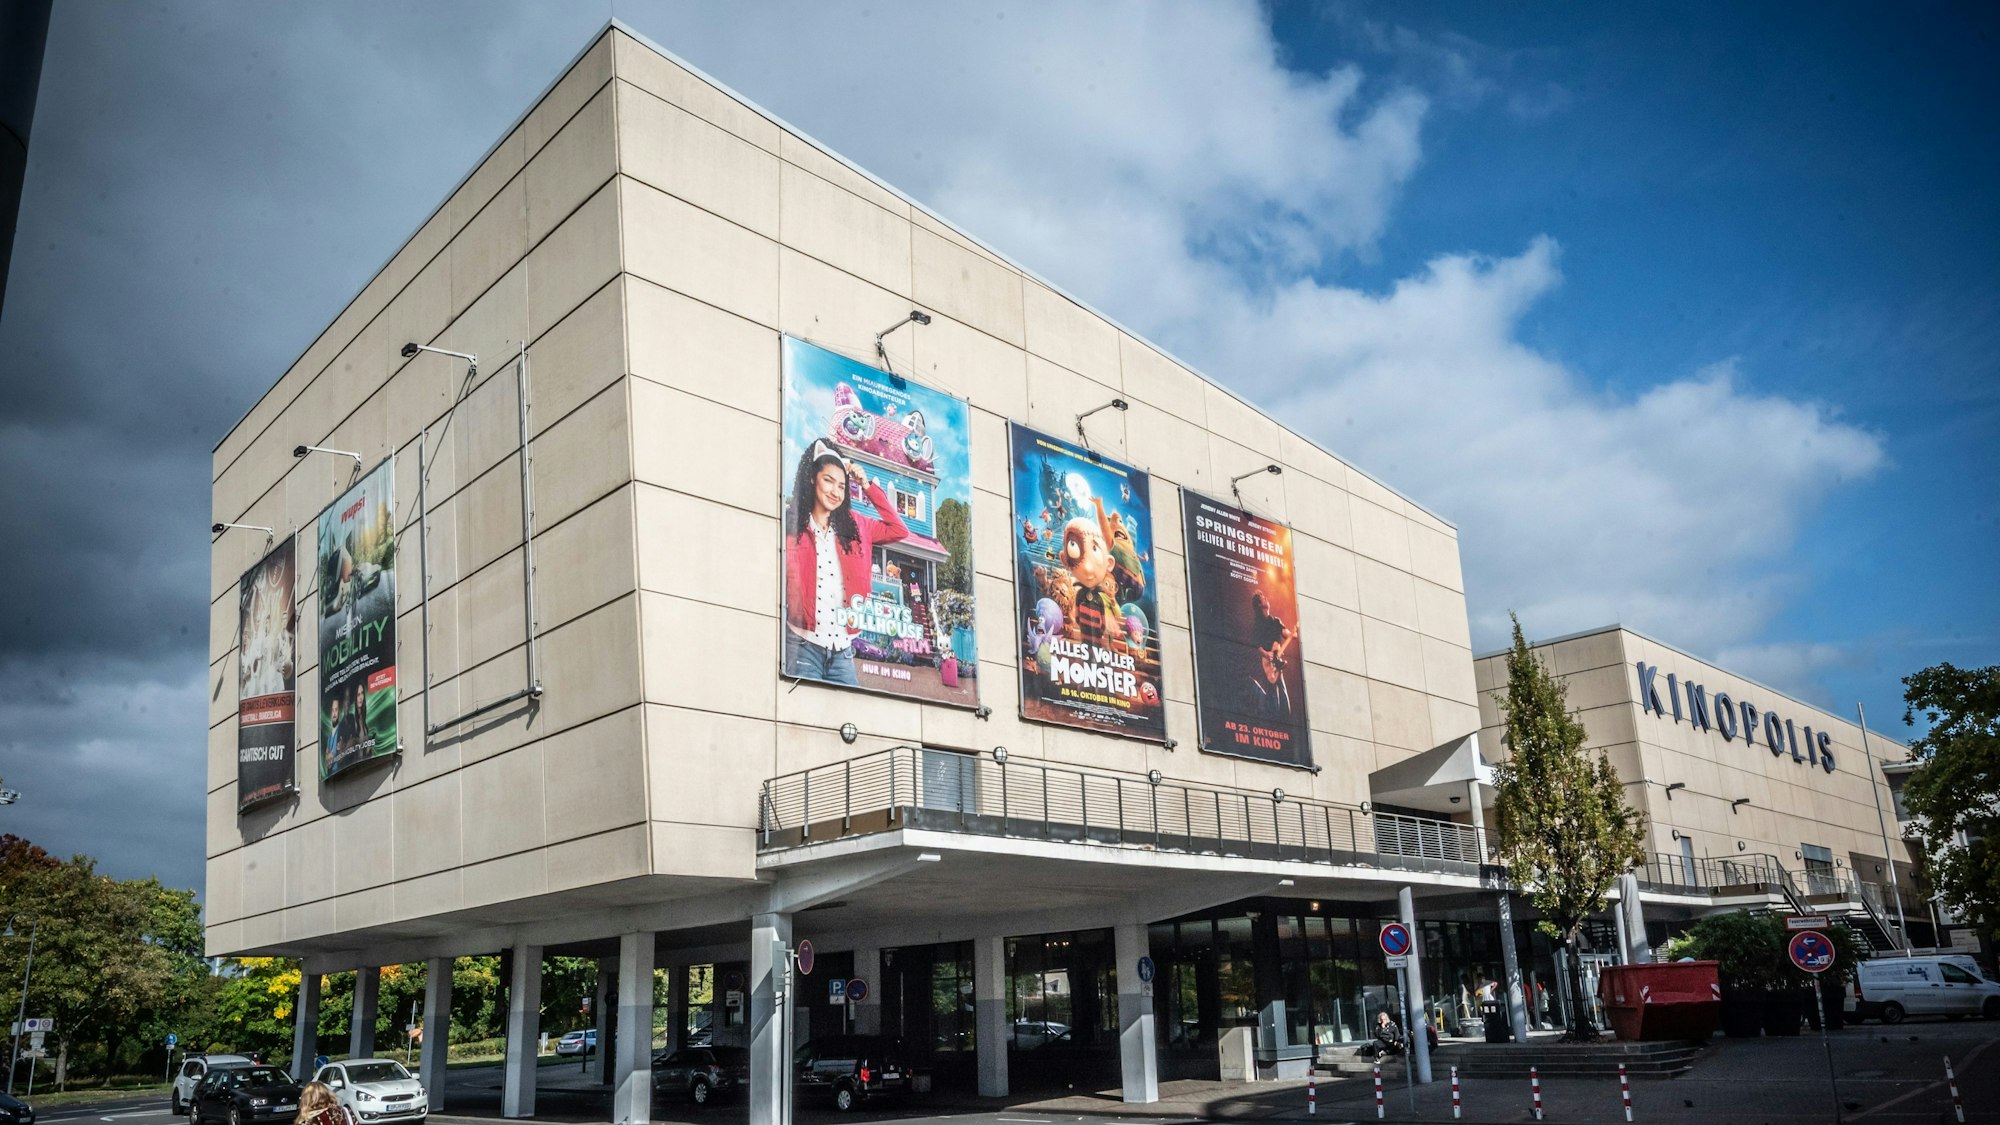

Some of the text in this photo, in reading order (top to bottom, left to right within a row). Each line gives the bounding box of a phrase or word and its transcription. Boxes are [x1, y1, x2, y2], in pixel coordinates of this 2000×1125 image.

[852, 374, 863, 383] EIN
[857, 384, 906, 405] KINOABENTEUER
[341, 489, 366, 525] wupsi
[1200, 504, 1216, 514] JEREMY
[1216, 509, 1229, 518] ALLEN
[1195, 515, 1284, 555] SPRINGSTEEN
[1197, 530, 1224, 548] DELIVER
[1226, 539, 1236, 552] ME
[1238, 542, 1255, 559] FROM
[837, 607, 924, 641] DOLLHOUSE
[322, 616, 389, 675] MOBILITY
[903, 638, 931, 655] FILM
[1049, 637, 1136, 671] ALLES VOLLER
[862, 664, 912, 681] NUR IM KINO
[1050, 654, 1138, 697] MONSTER
[1061, 688, 1071, 696] AB
[1071, 690, 1080, 698] 16.
[1080, 691, 1109, 704] OKTOBER
[1116, 699, 1131, 709] KINO
[1637, 660, 1836, 774] KINOPOLIS
[1225, 721, 1290, 741] AB 23. OKTOBER
[1235, 733, 1282, 751] IM KINO
[268, 745, 285, 761] GUT
[833, 981, 842, 994] P
